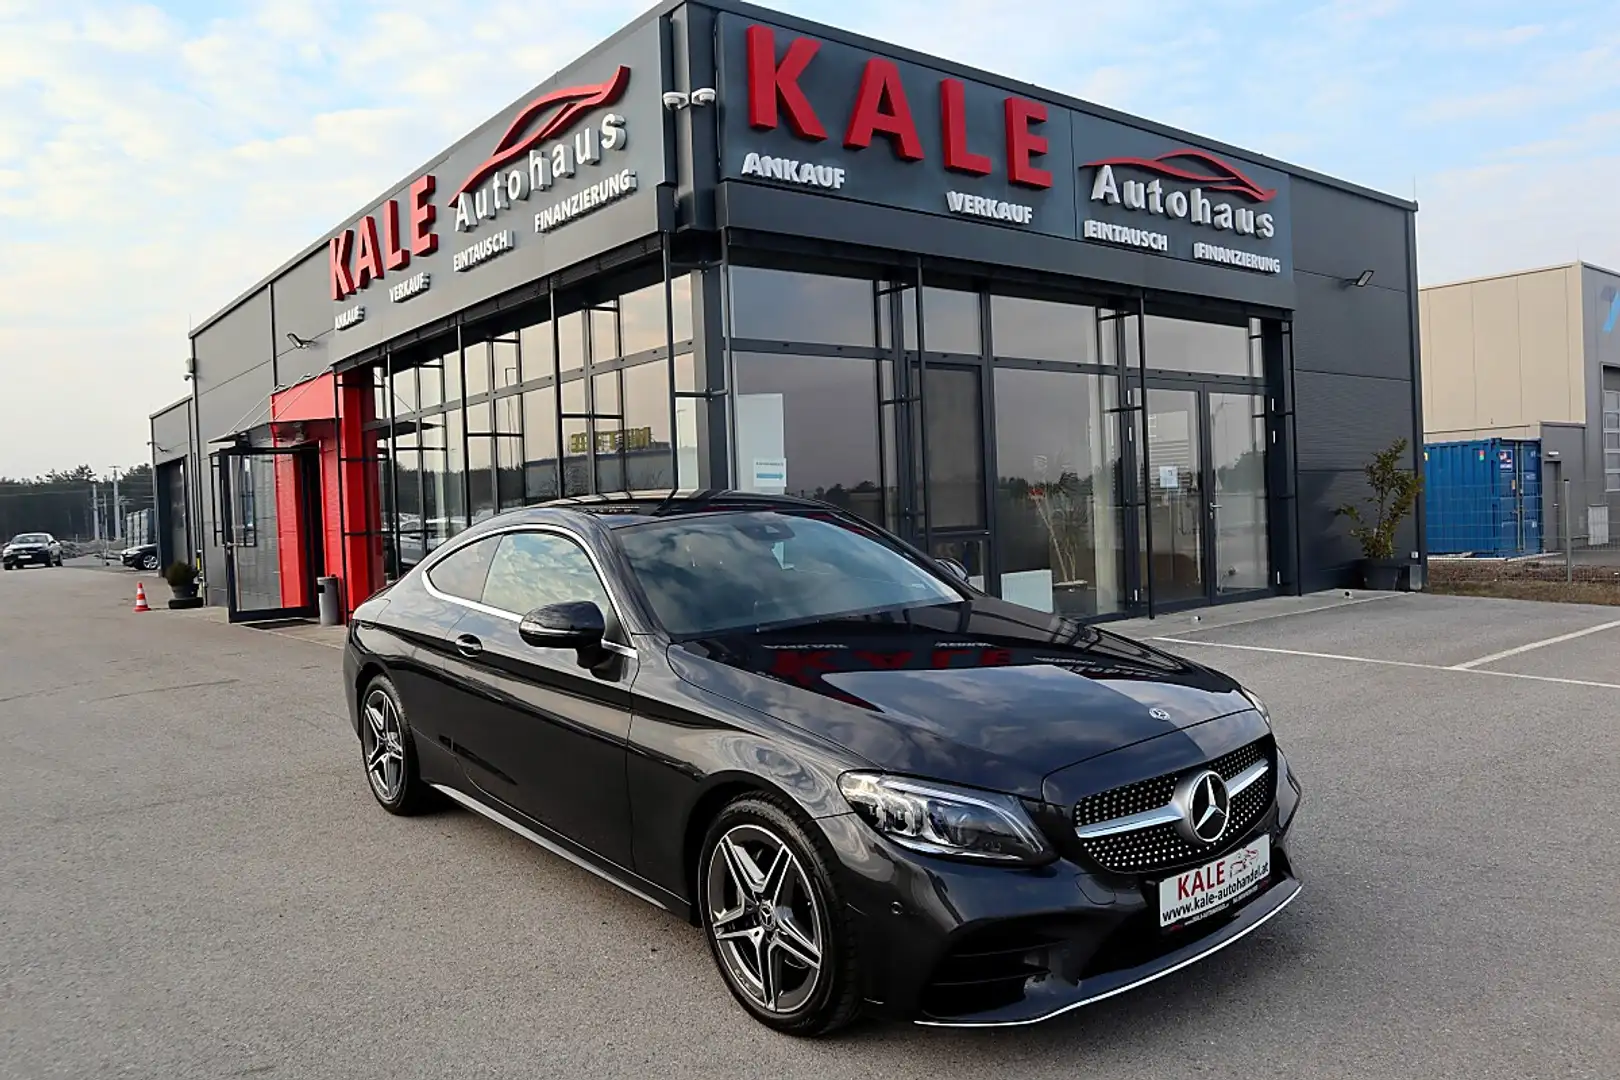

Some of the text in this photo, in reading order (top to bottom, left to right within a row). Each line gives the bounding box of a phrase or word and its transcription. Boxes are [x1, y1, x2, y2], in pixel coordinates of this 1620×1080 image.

[746, 24, 1274, 239] KALE Autohaus
[330, 113, 627, 300] KALE Autohaus
[389, 272, 430, 302] VERKAUF
[453, 230, 515, 272] EINTAUSCH
[534, 169, 637, 232] FINANZIERUNG
[741, 152, 1281, 273] ANKAUF VERKAUF EINTAUSCH FINANZIERUNG
[1162, 862, 1269, 921] www.kale-autohandel.at
[1178, 862, 1226, 901] KALE
